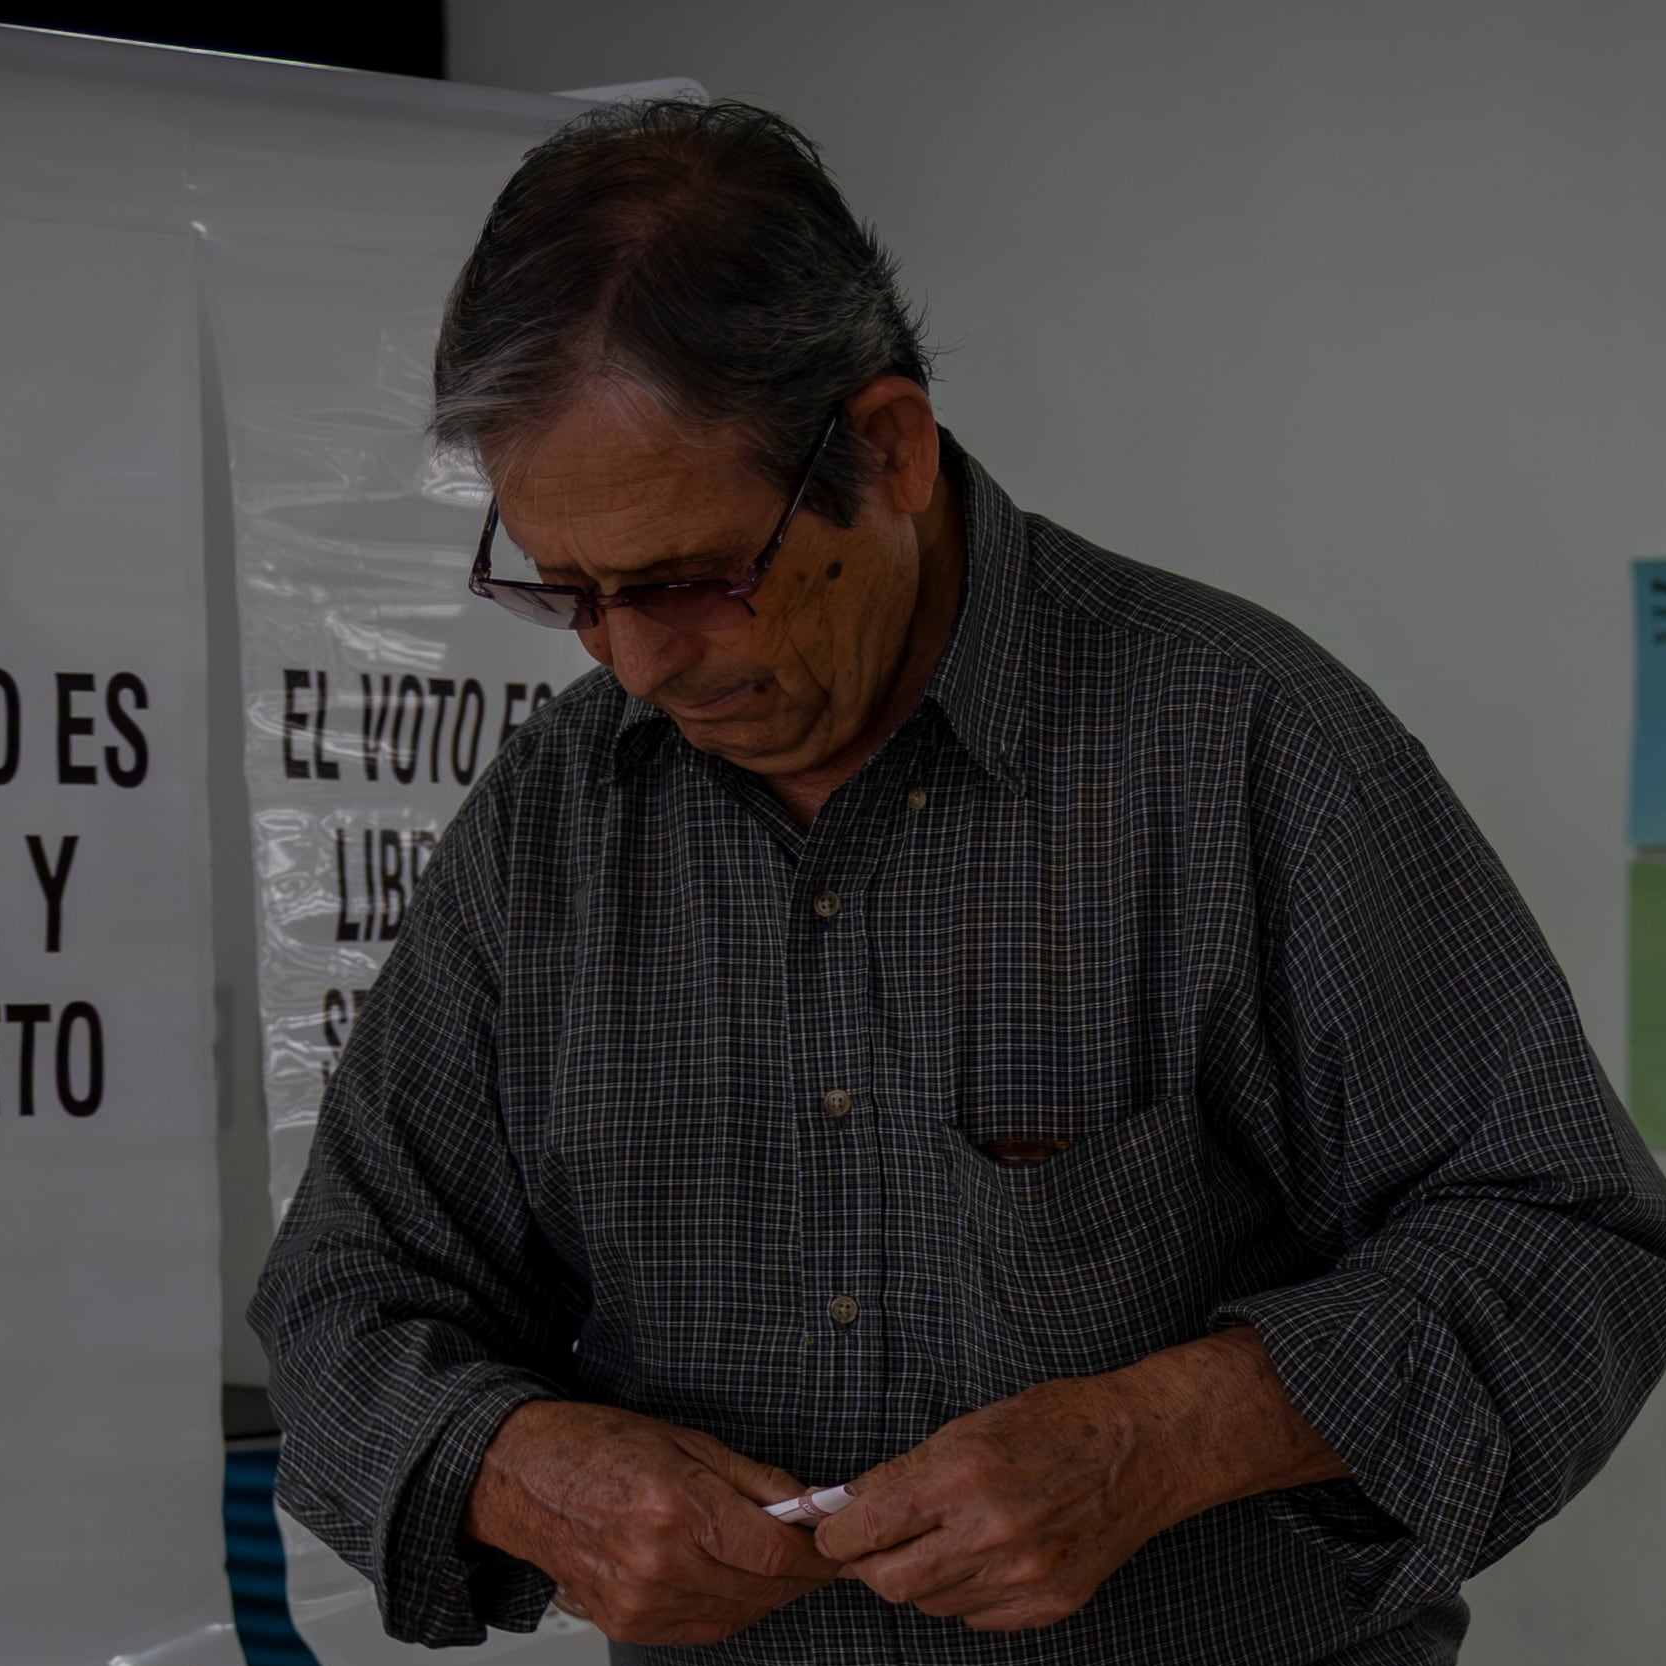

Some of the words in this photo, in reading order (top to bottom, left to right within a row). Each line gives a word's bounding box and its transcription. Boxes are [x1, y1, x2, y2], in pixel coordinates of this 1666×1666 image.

[55, 671, 149, 789] ES
[283, 668, 340, 781] EL
[361, 672, 486, 787] VOTO
[25, 834, 80, 953] Y
